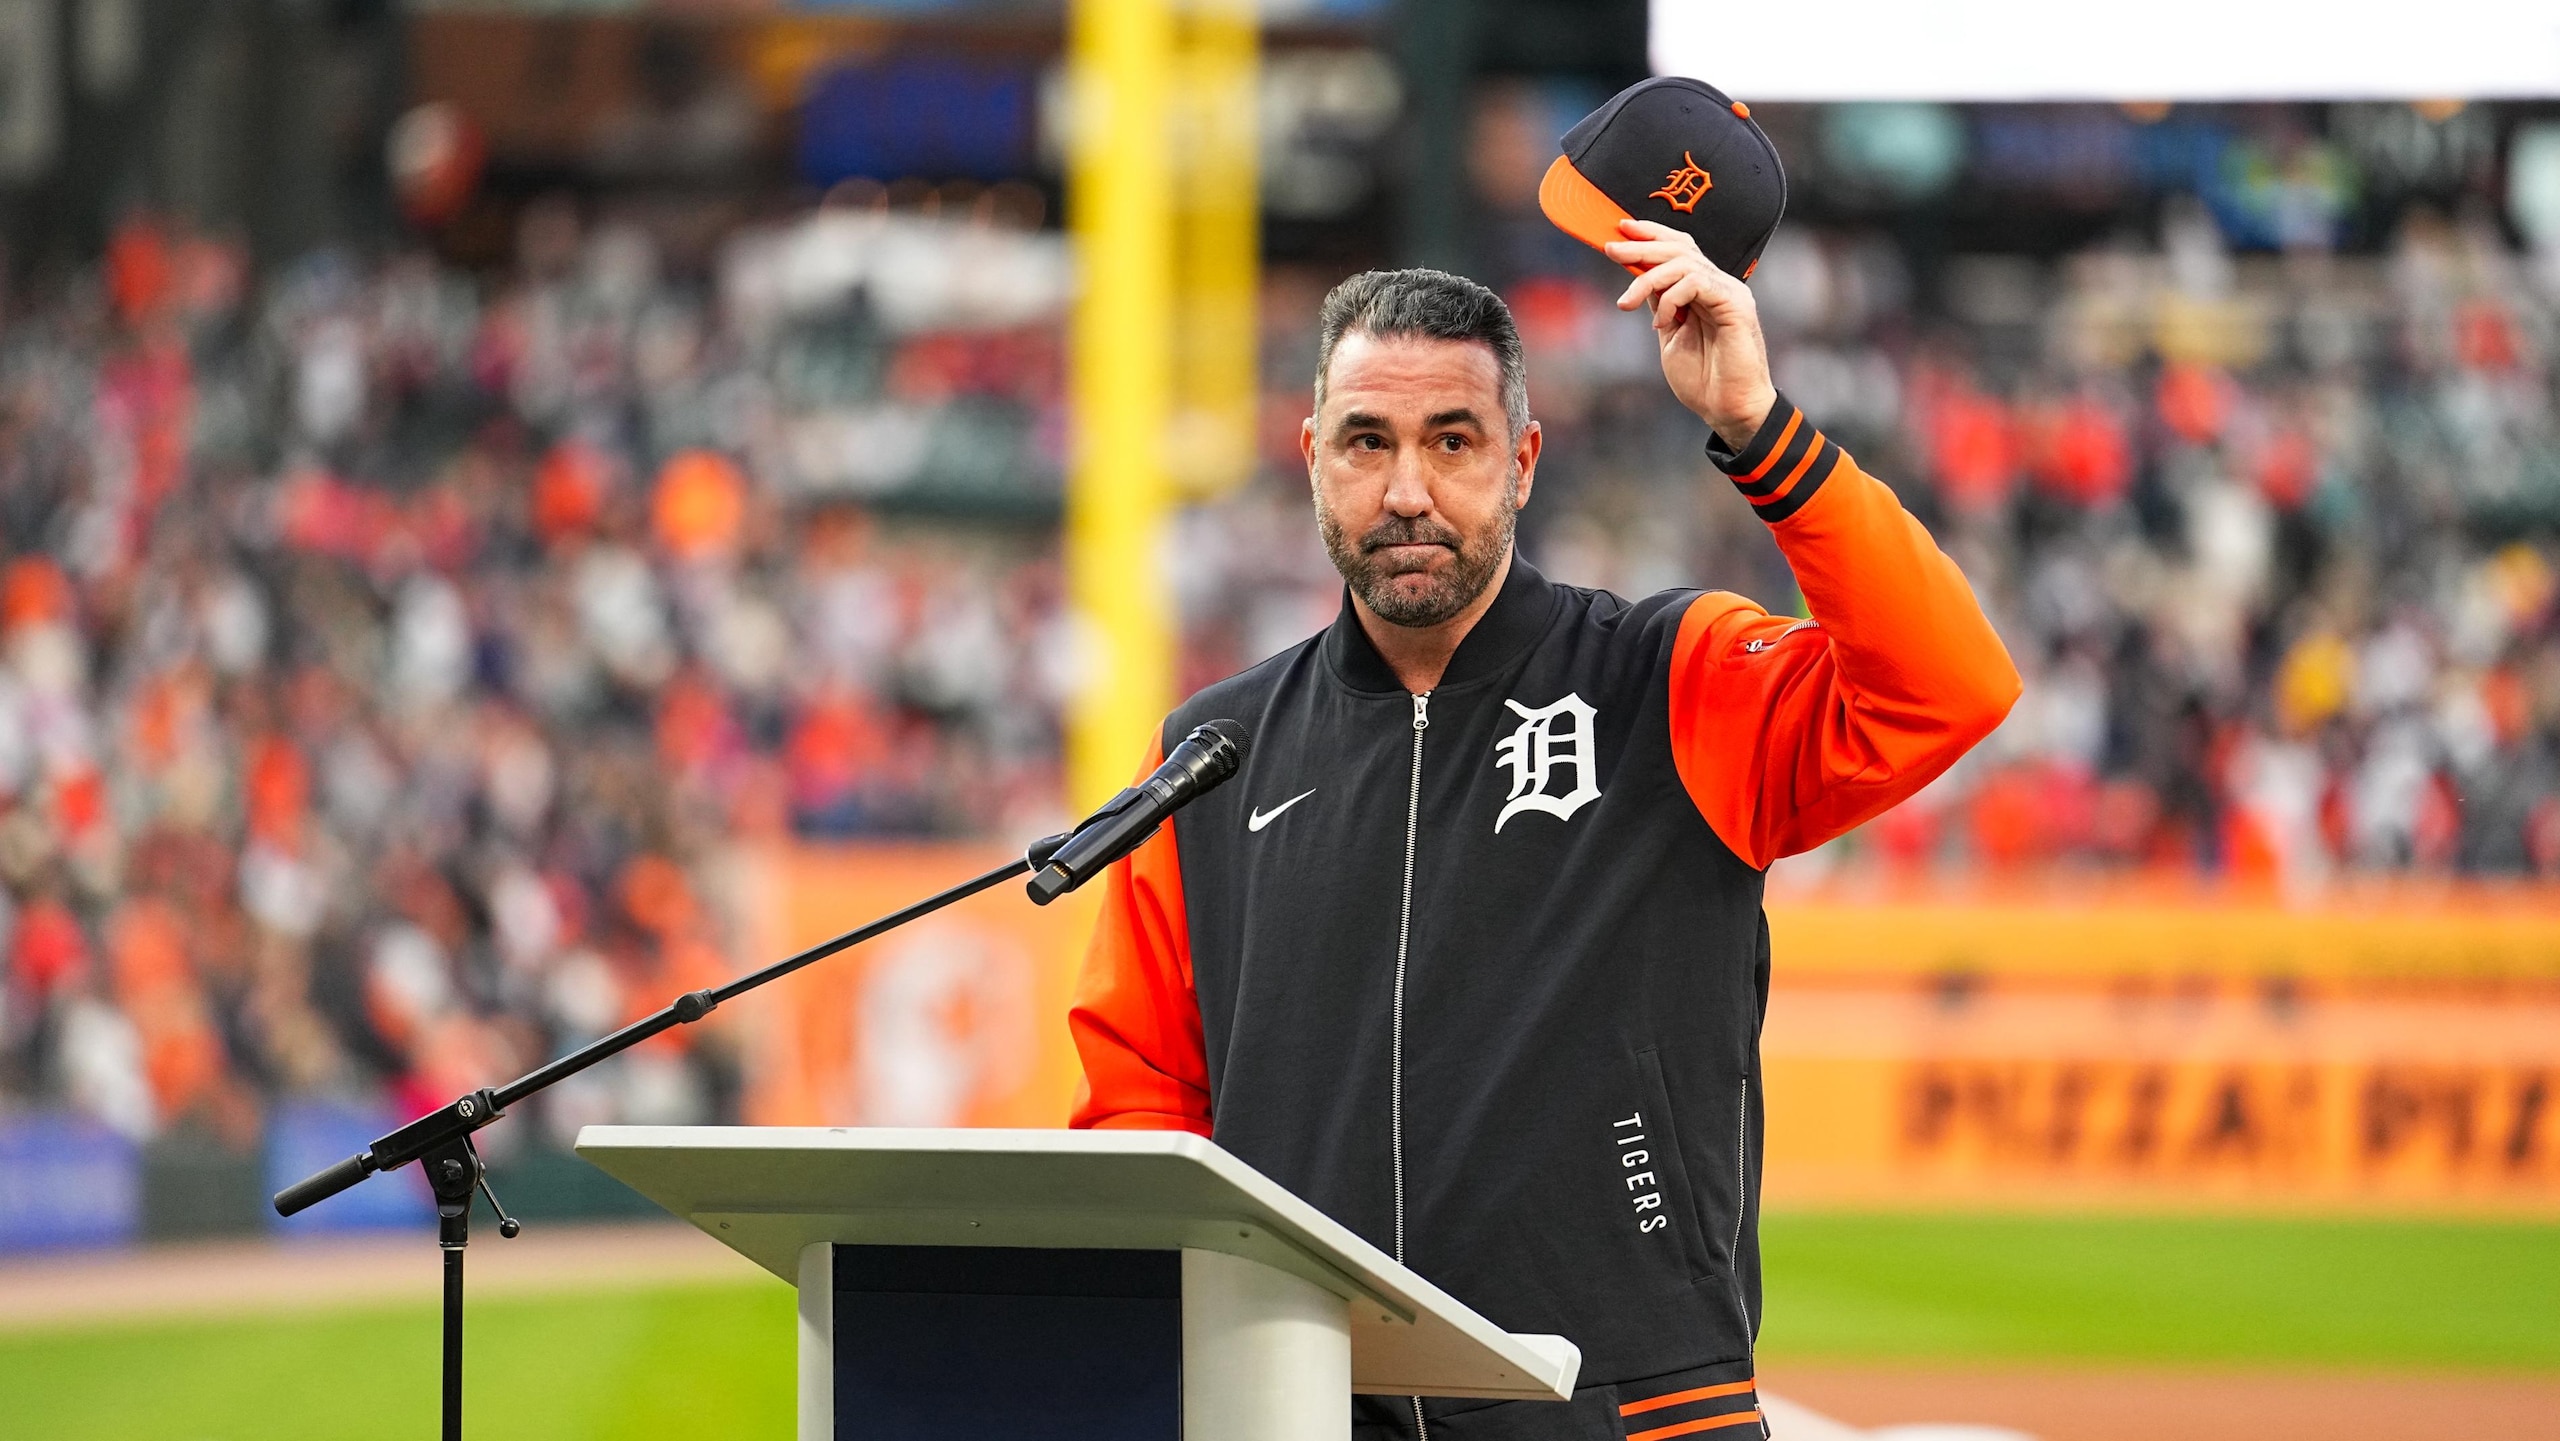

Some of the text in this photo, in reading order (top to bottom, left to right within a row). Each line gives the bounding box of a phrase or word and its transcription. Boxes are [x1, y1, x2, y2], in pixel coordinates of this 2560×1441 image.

[1648, 150, 1714, 215] D
[1495, 692, 1602, 835] D
[1613, 1112, 1667, 1234] TIGERS
